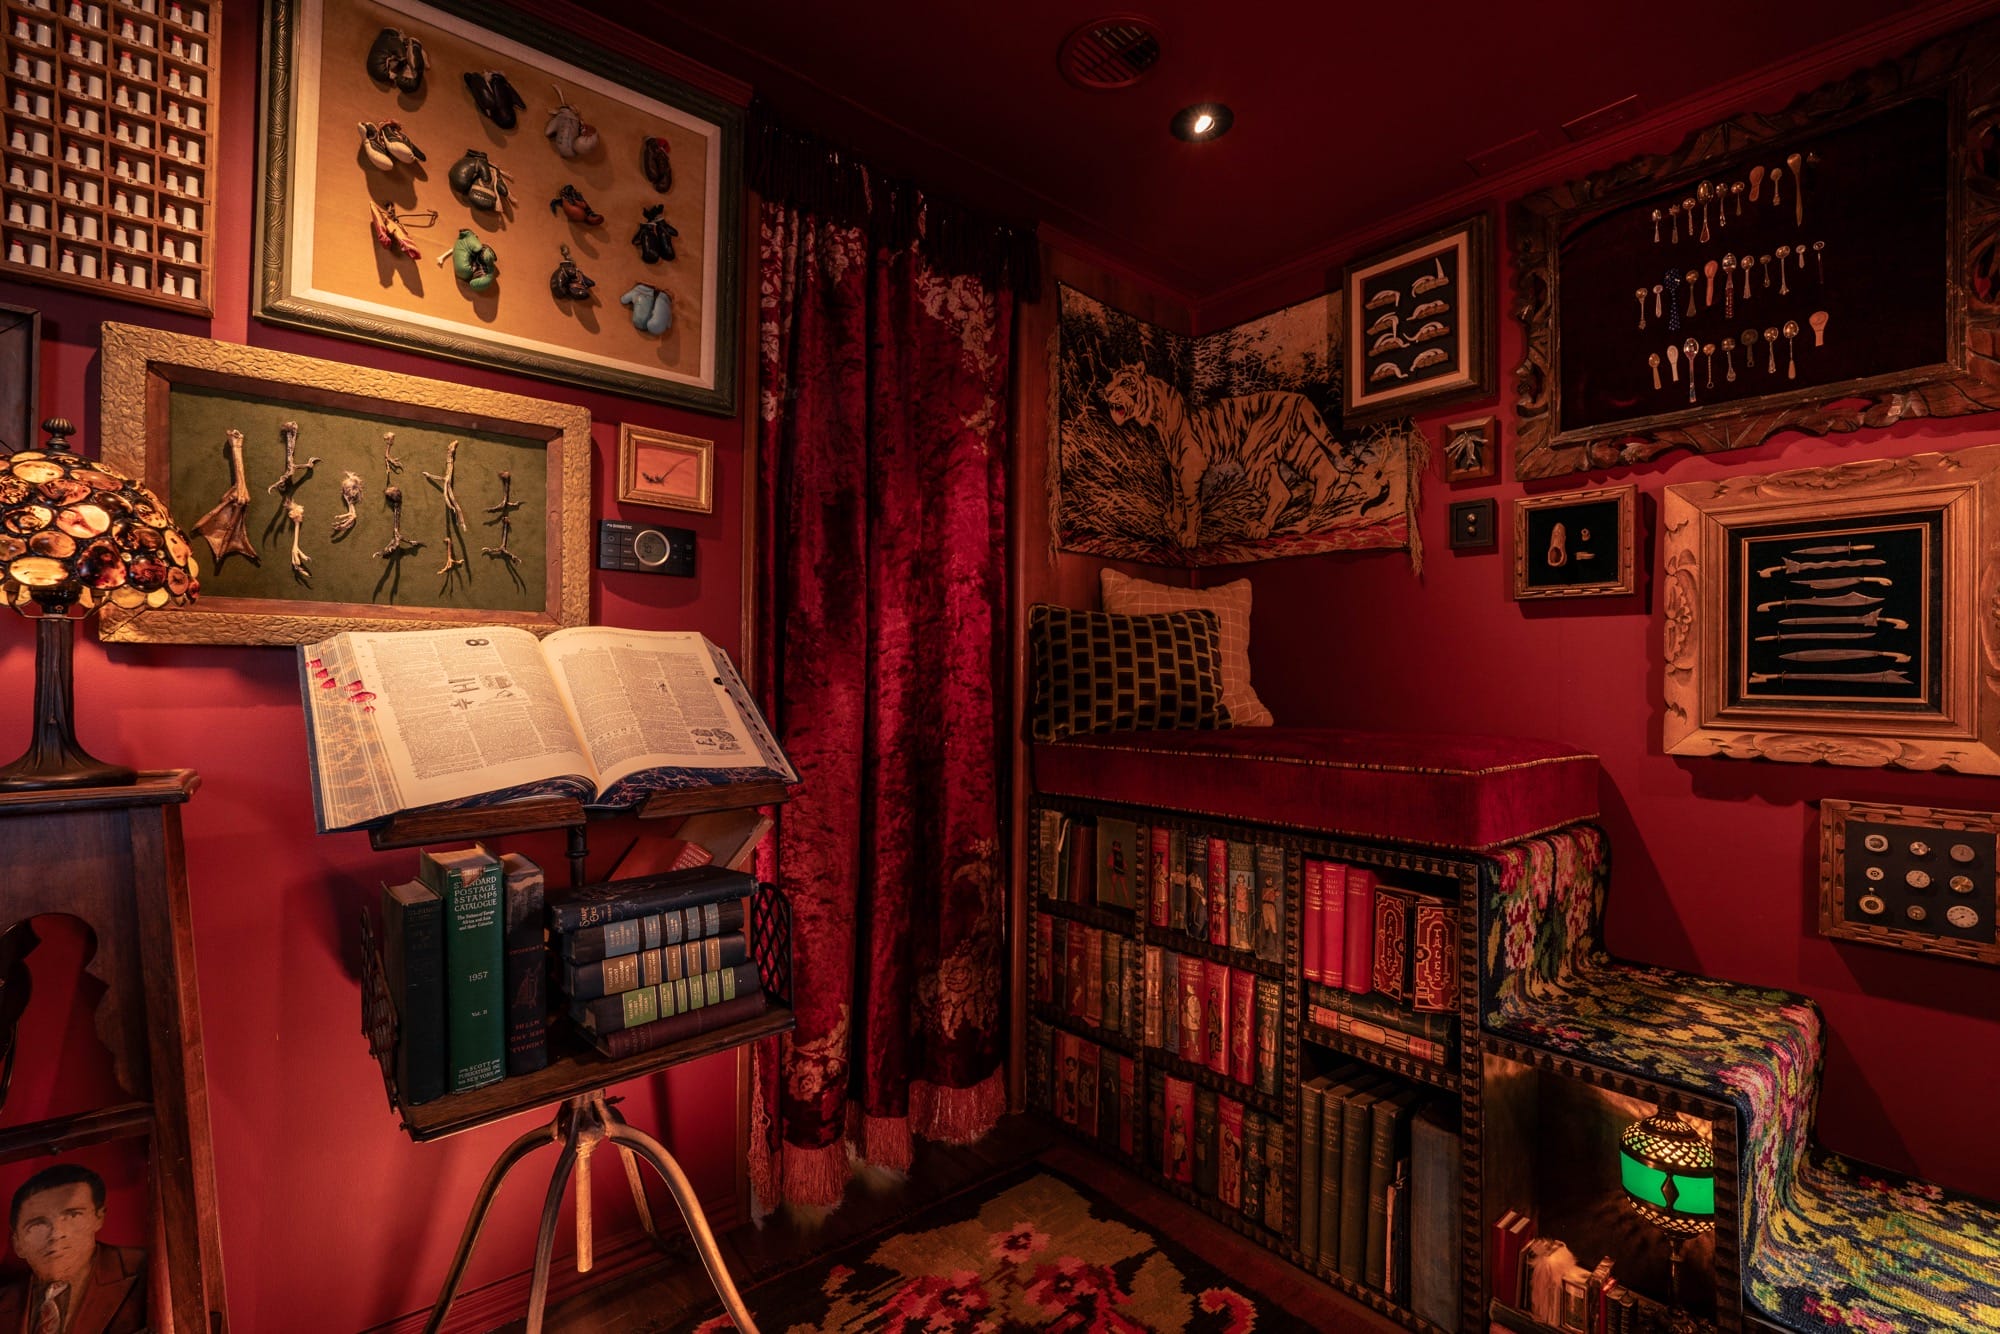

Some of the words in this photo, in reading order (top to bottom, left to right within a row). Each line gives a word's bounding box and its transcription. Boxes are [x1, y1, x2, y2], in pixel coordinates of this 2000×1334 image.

[454, 876, 496, 890] STDARD
[454, 884, 496, 897] POSTAGE
[454, 898, 497, 912] CATALOGUE
[469, 971, 488, 982] 1957
[470, 1061, 491, 1072] SCOTT
